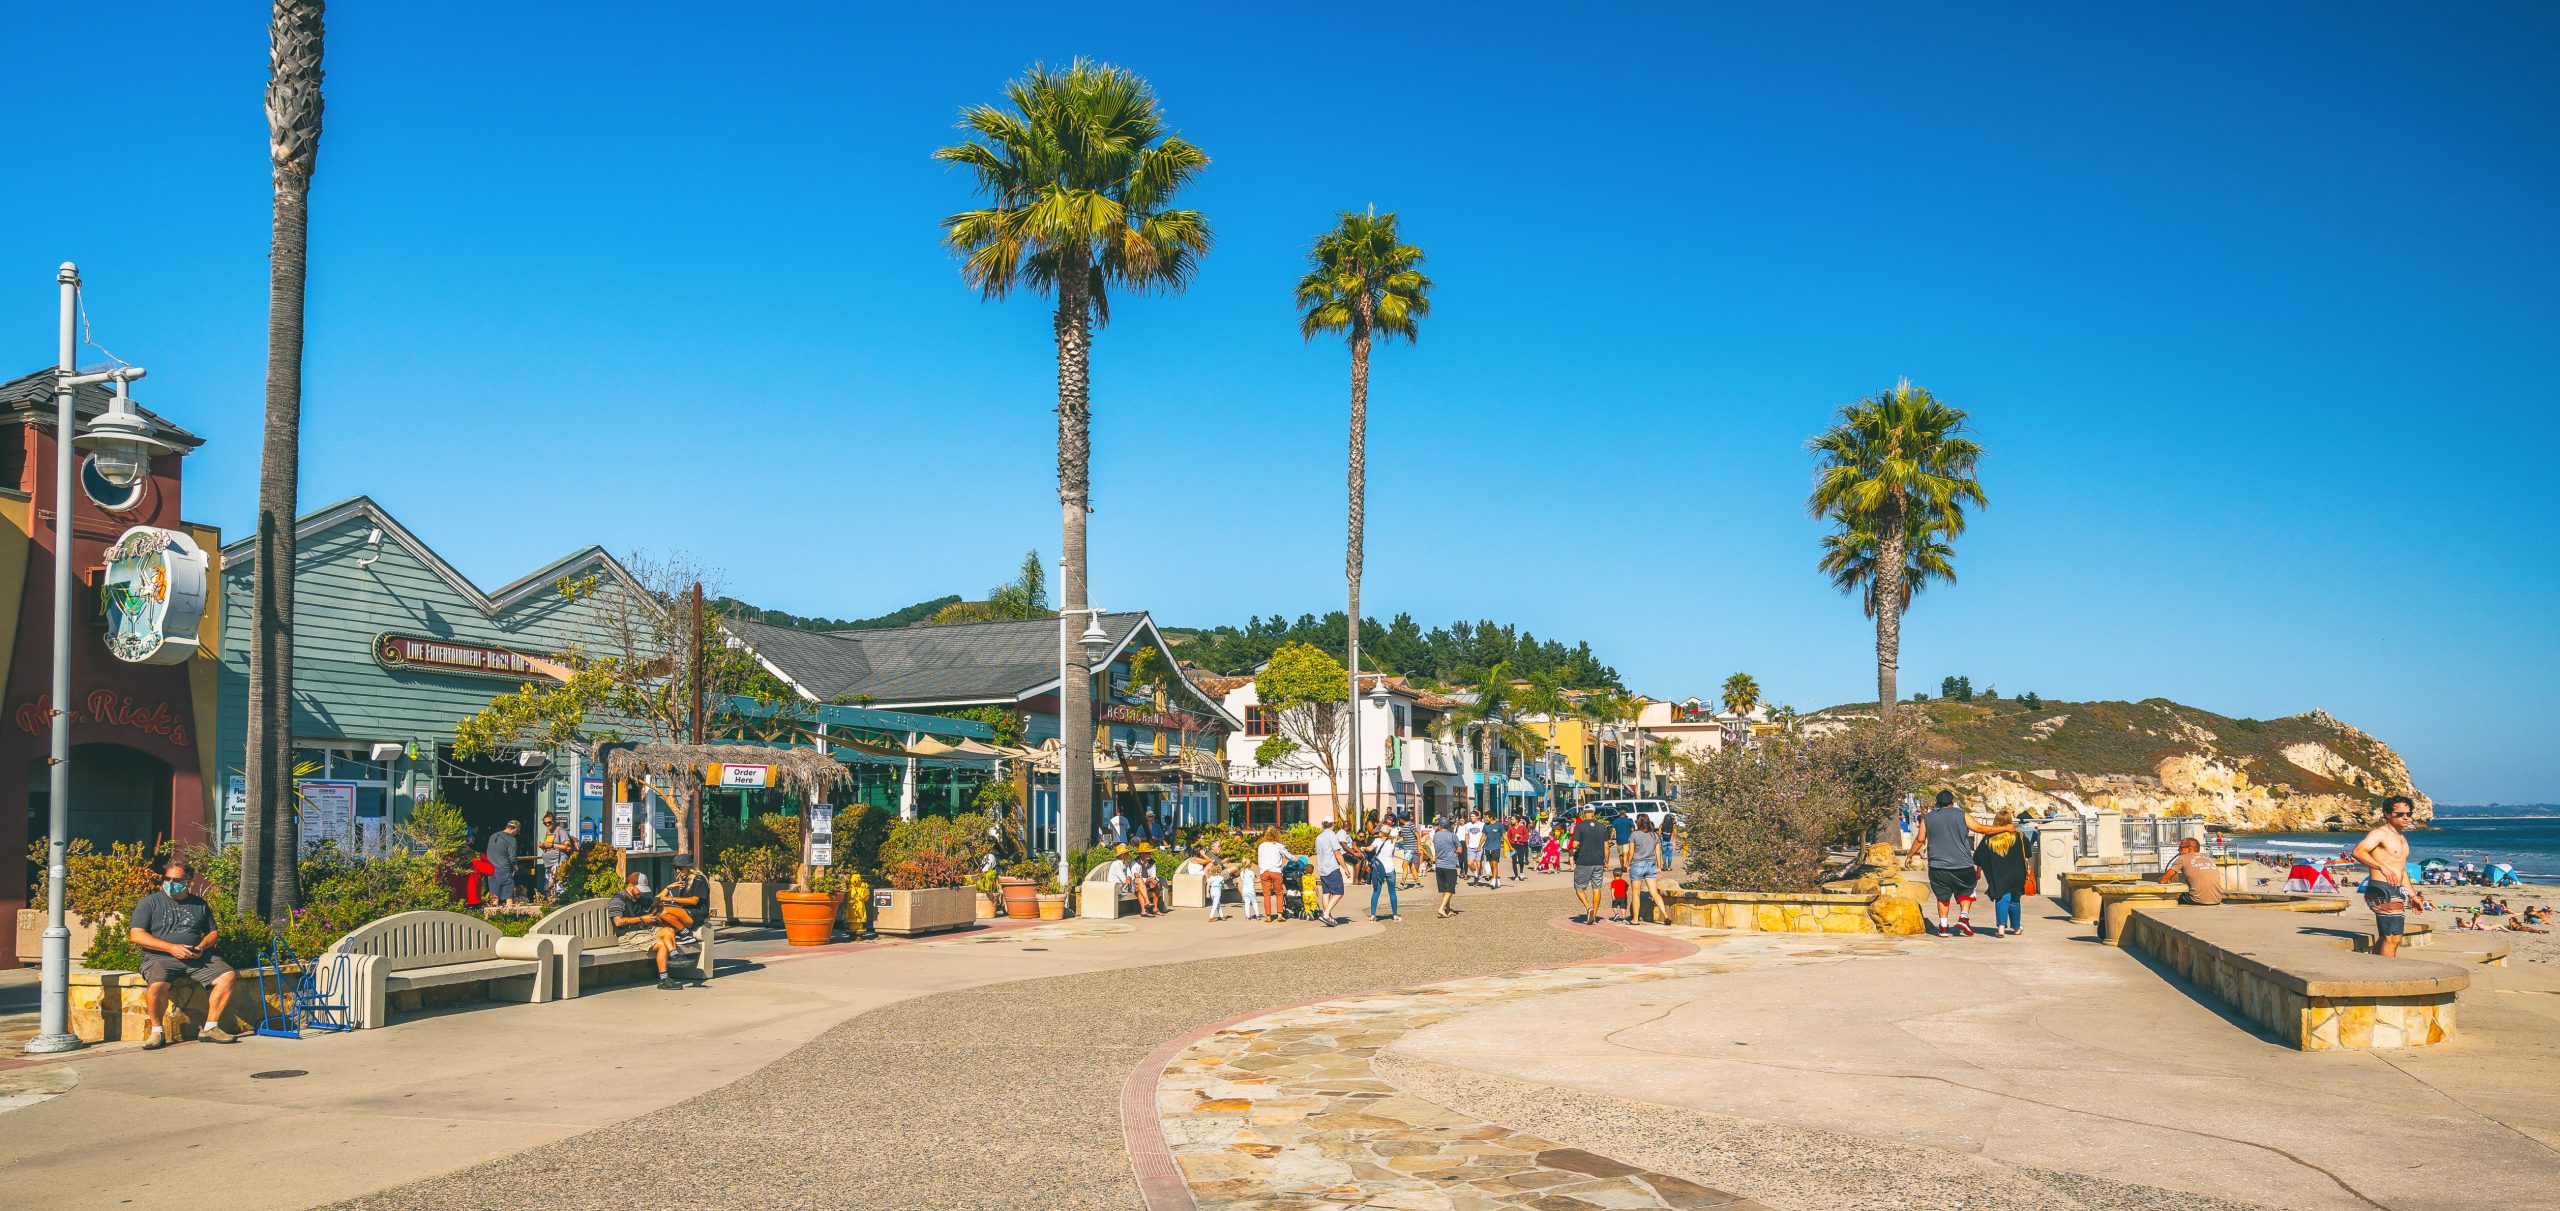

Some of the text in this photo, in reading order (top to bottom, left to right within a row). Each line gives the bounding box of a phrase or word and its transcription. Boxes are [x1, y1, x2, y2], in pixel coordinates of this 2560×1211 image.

[407, 641, 423, 659] LIVE
[426, 643, 482, 666] ENTERTAINMENT
[487, 651, 509, 670] BEACH
[87, 689, 190, 746] Rick's
[734, 768, 757, 776] Order
[735, 776, 754, 784] Here
